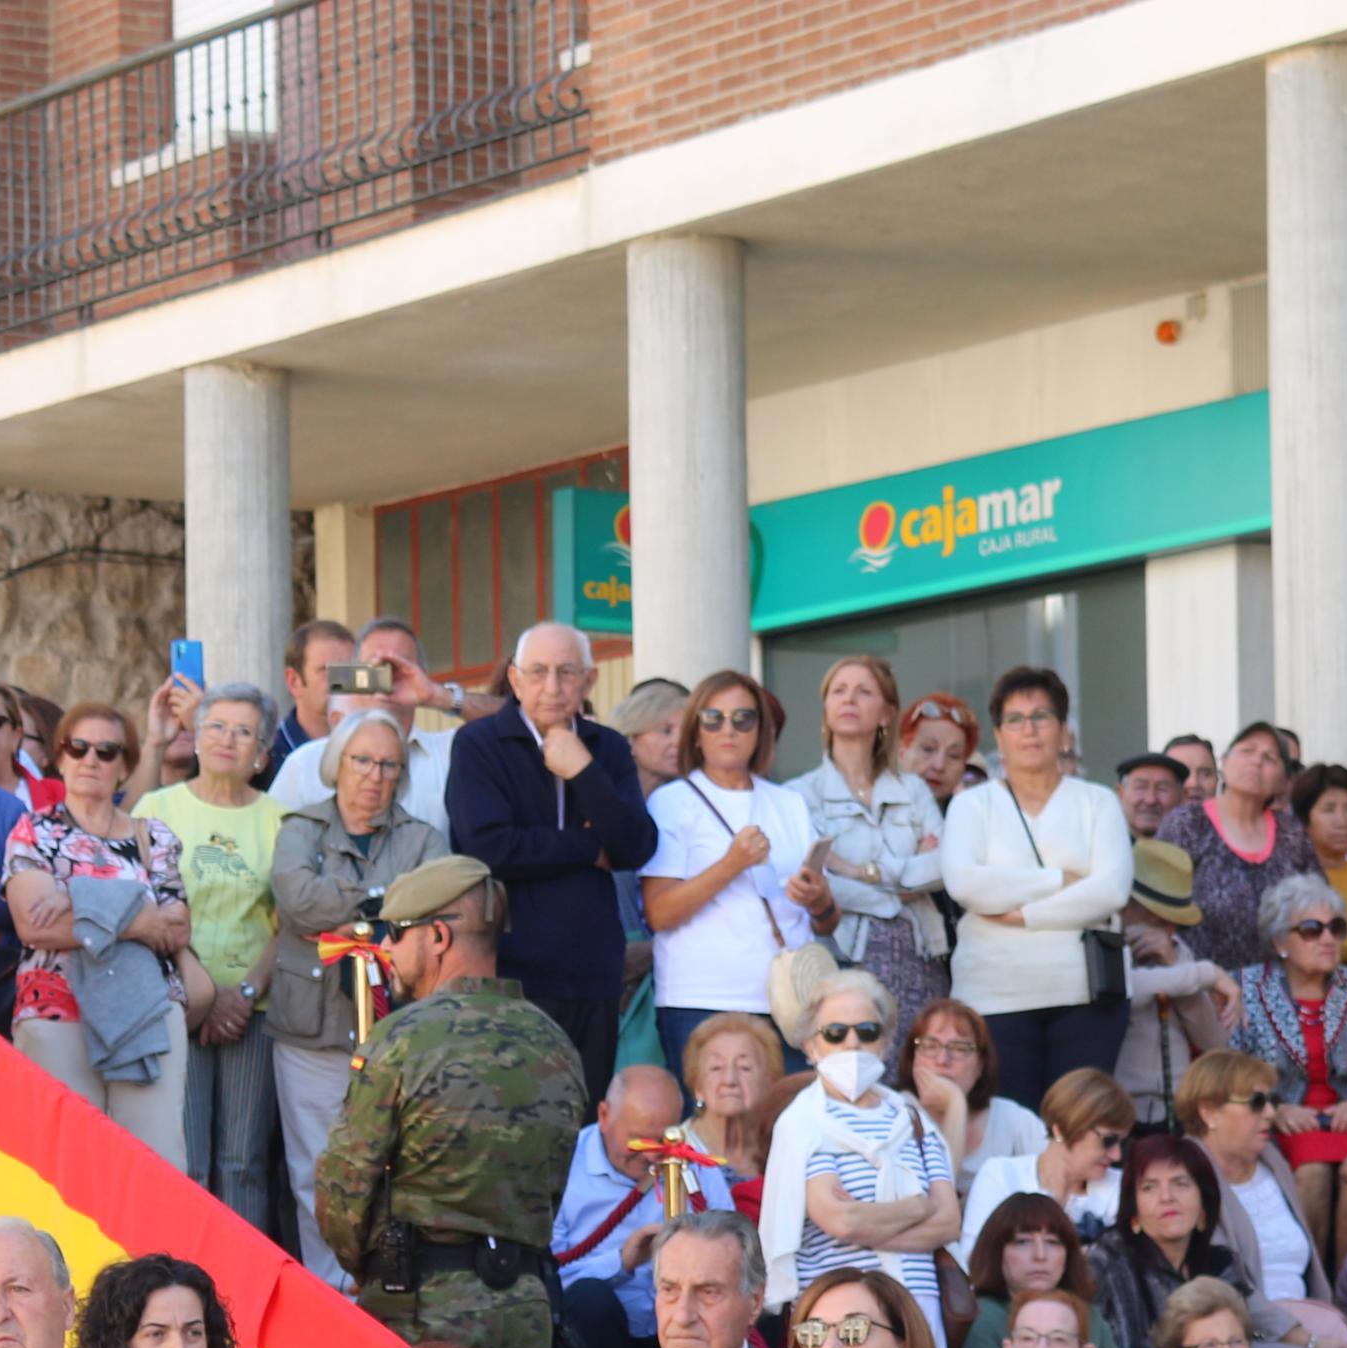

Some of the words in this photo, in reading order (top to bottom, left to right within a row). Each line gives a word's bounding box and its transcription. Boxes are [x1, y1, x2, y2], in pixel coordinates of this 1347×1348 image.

[899, 478, 1062, 558] cajamar
[978, 533, 1013, 556] CAJA
[1014, 525, 1058, 549] RURAL
